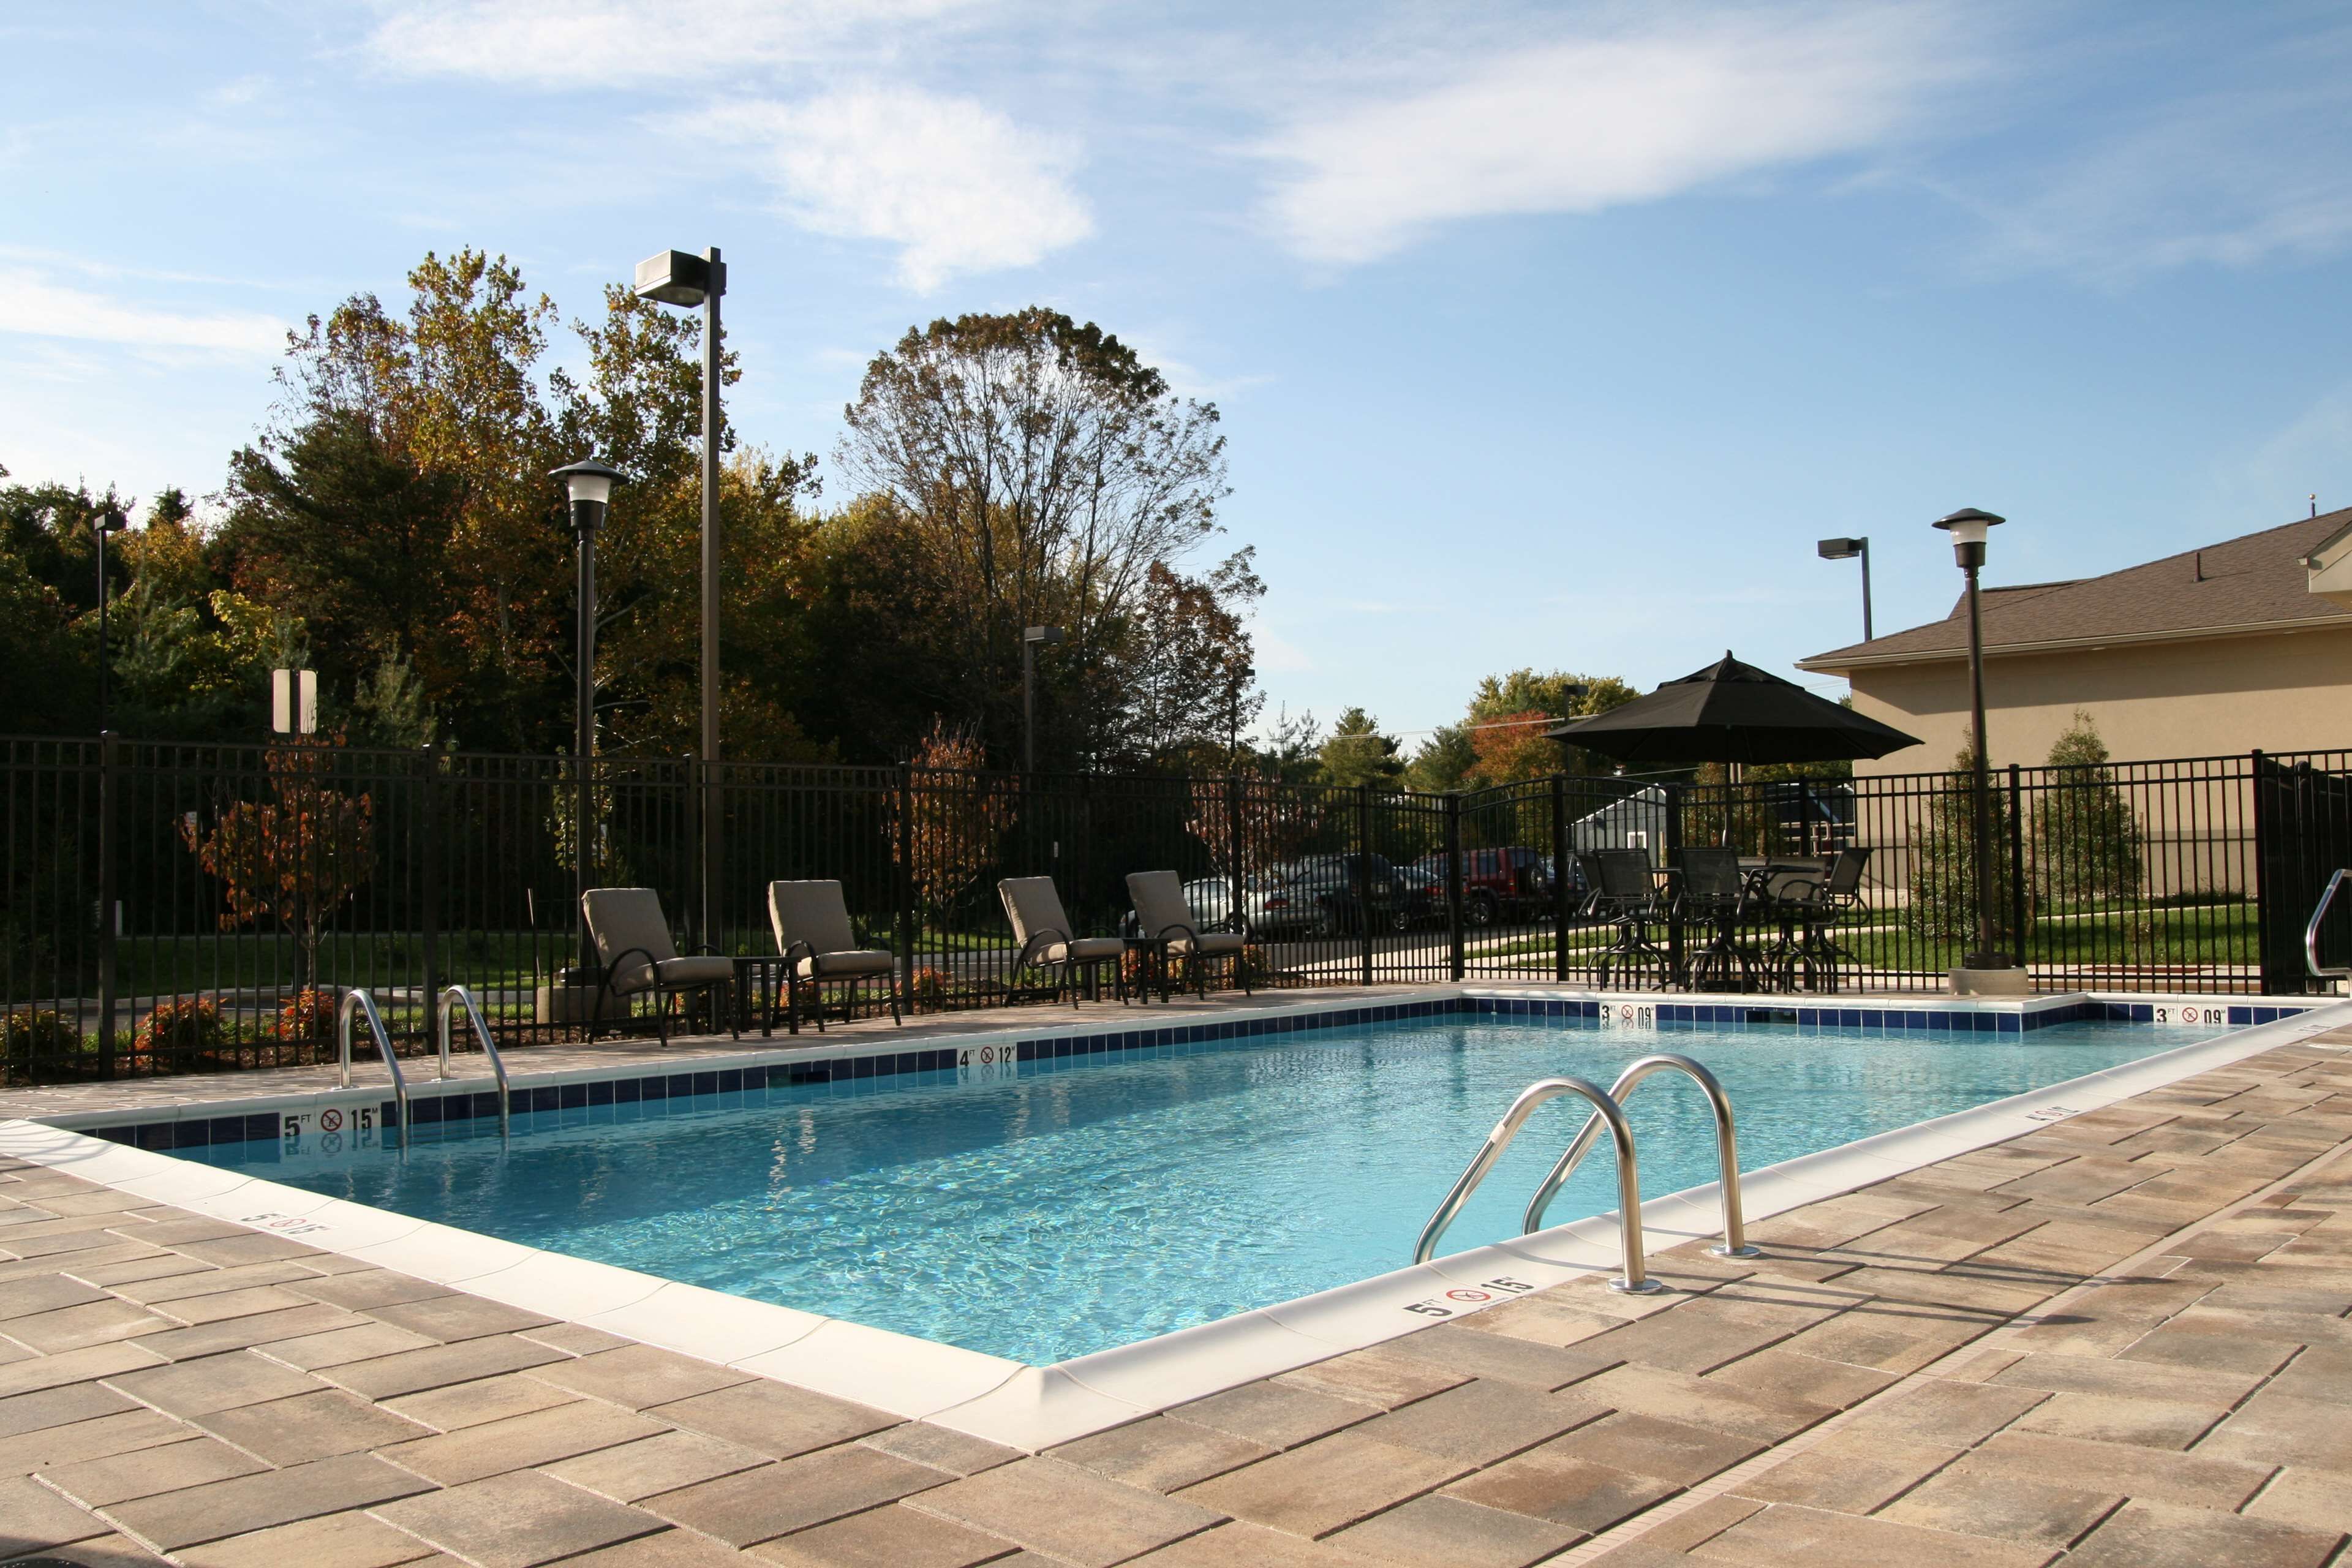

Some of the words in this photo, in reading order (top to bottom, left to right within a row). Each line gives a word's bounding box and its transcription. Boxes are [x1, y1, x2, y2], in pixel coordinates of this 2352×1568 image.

[1602, 1005, 1610, 1019] 3
[2156, 1008, 2166, 1022] 3
[960, 1050, 969, 1066] 4
[999, 1046, 1011, 1063] 12
[284, 1115, 300, 1137] 5
[301, 1114, 311, 1123] FT
[1403, 1303, 1452, 1317] 5
